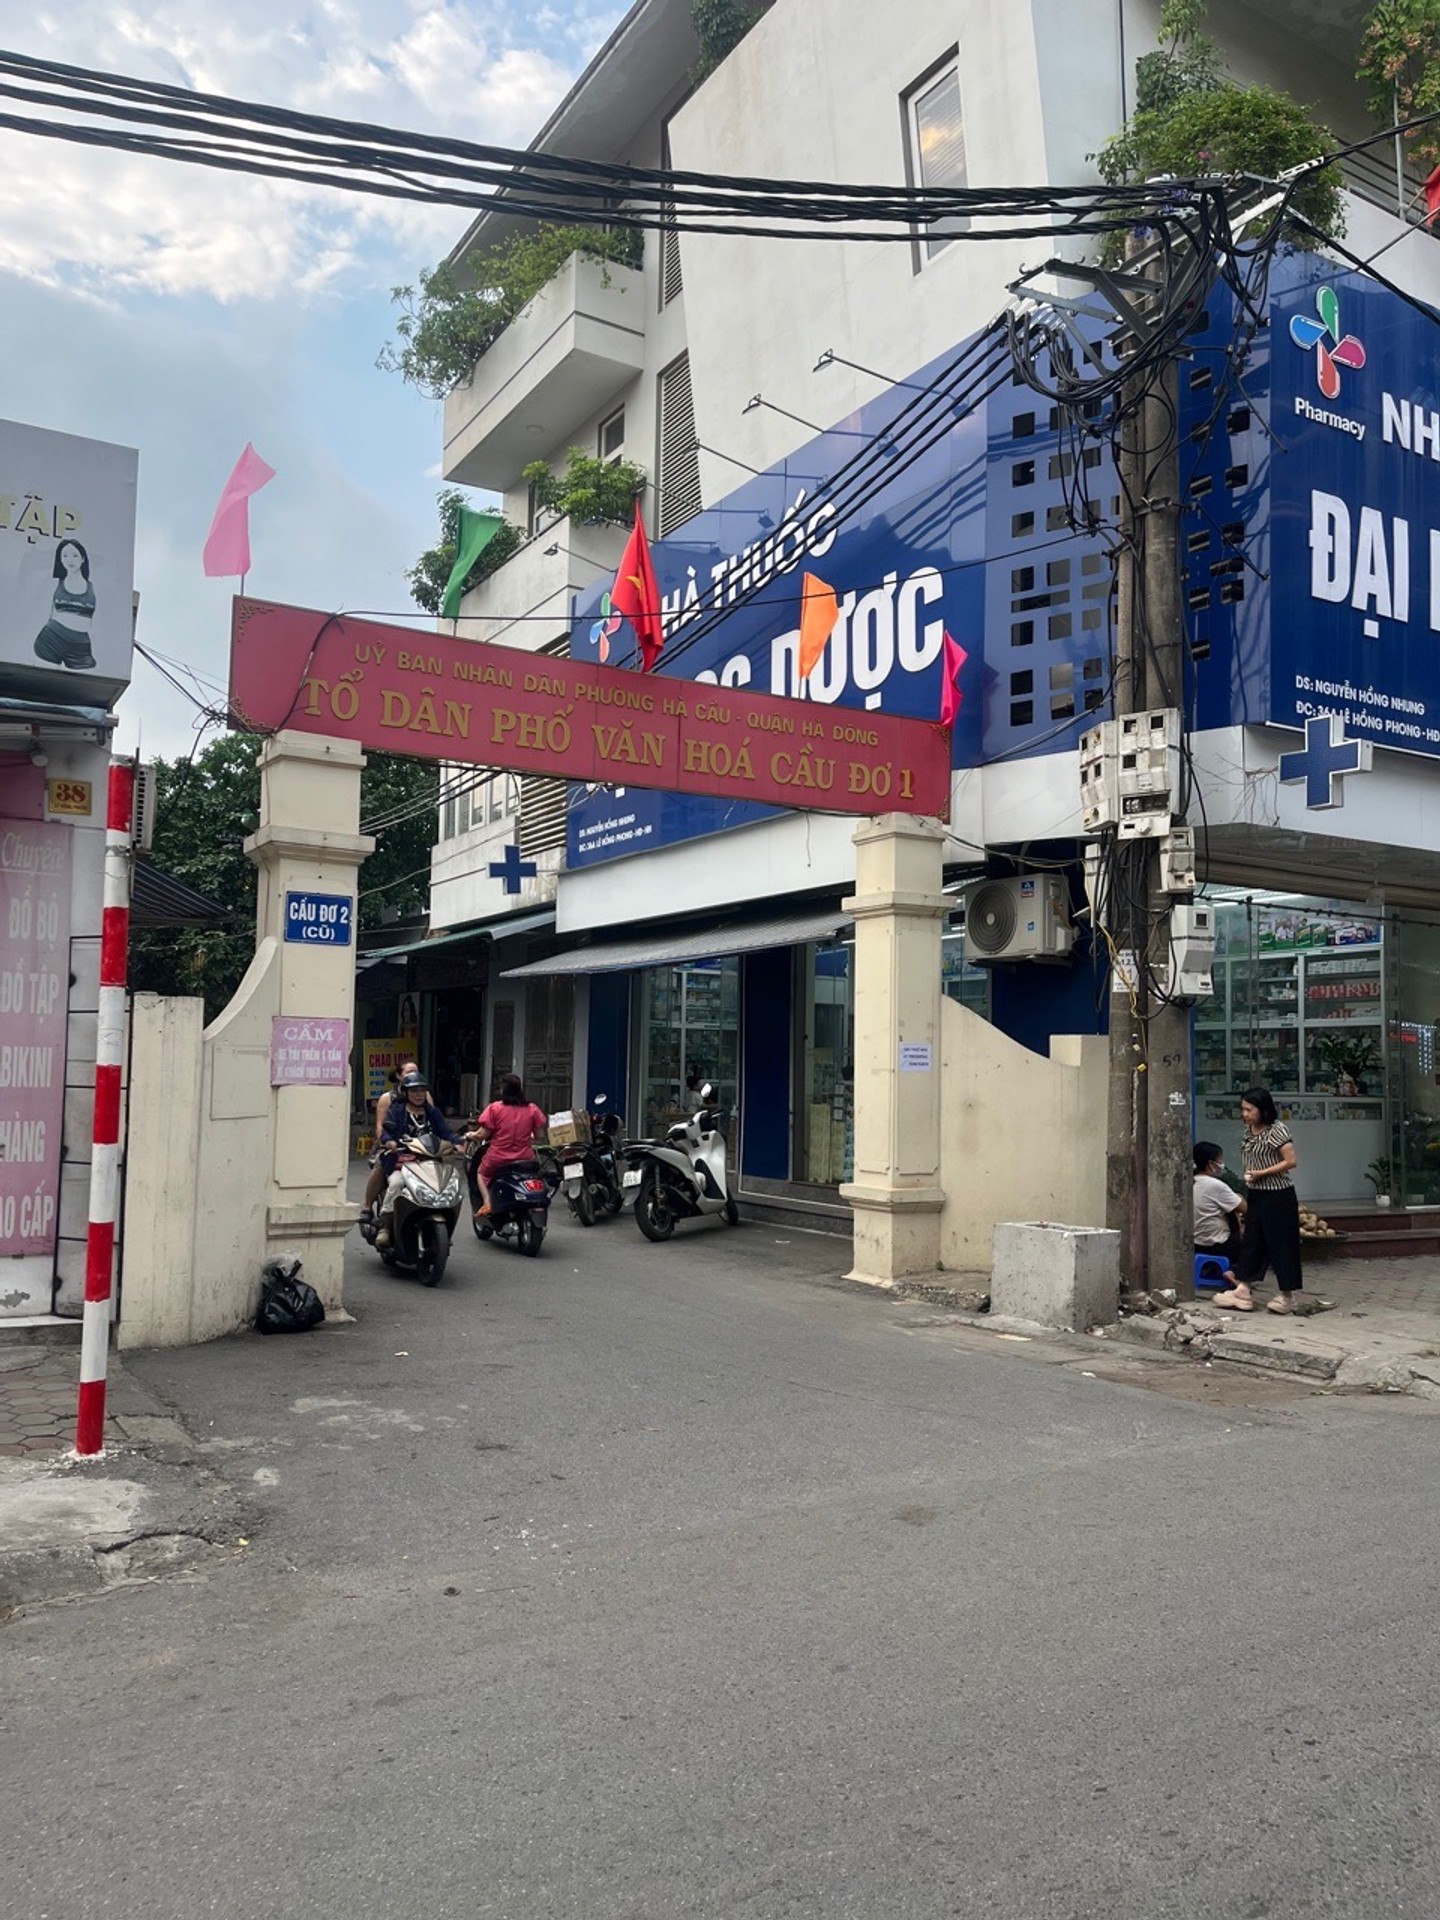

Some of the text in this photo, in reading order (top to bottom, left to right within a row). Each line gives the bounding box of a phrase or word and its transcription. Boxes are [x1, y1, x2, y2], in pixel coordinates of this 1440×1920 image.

[1294, 396, 1366, 442] Pharmacy
[710, 487, 838, 608] THUỐC
[1308, 488, 1408, 639] ĐẠI
[355, 640, 387, 665] UỶ
[397, 651, 443, 676] BAN
[453, 661, 514, 688] NHÂN
[523, 673, 566, 698] DÂN
[574, 684, 655, 713] PHƯỜNG
[663, 698, 688, 719] HÀ
[747, 711, 795, 736] QUẬN
[802, 718, 826, 739] HÀ
[833, 724, 880, 747] ĐÔNG
[1295, 674, 1425, 716] DS: NGUYỄN HỒNG NHUNG
[300, 669, 915, 799] TỔ DÂN PHỐ VĂN HOÁ CẦU ĐƠ 1
[1352, 708, 1383, 731] HỒNG
[56, 783, 86, 803] 38
[302, 924, 335, 940] (CŨ)
[319, 904, 338, 923] ĐƠ
[340, 905, 349, 924] 2
[29, 963, 60, 1025] TẬP
[283, 1021, 335, 1041] CẤM
[0, 1046, 52, 1089] BIKINI
[0, 1110, 46, 1163] HÀNG
[20, 1178, 54, 1238] CẤP
